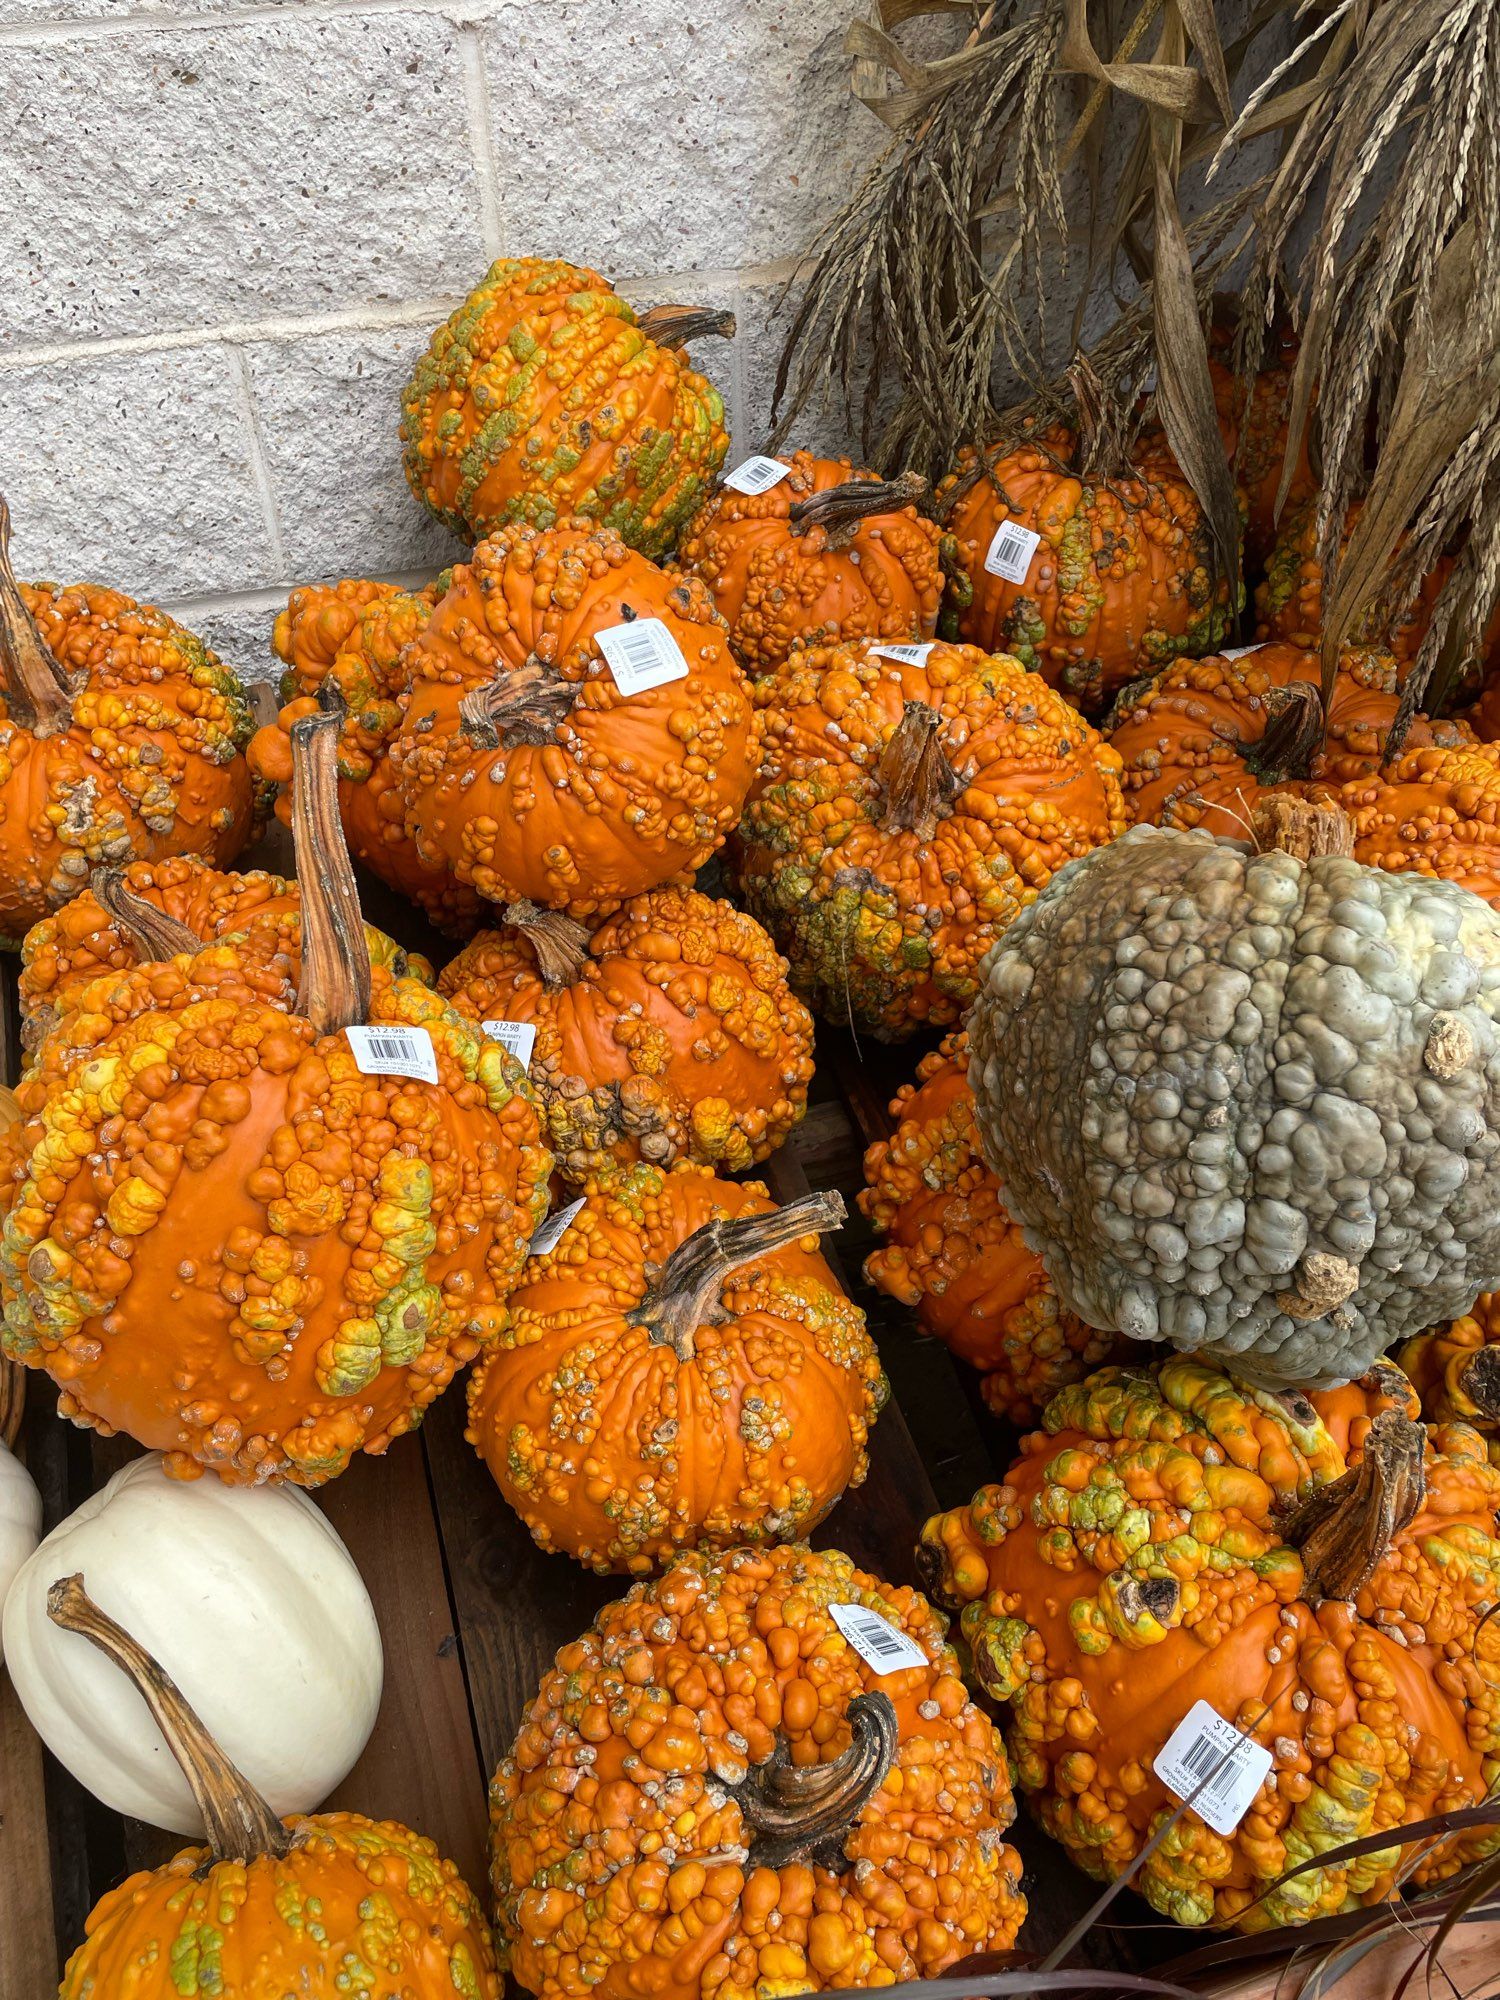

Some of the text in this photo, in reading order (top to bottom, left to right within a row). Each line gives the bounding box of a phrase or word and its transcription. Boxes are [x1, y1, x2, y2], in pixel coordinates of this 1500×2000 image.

[1010, 525, 1030, 539] $12.98
[603, 646, 625, 677] $12.98
[494, 1022, 520, 1033] $12.98
[842, 1627, 871, 1657] $12.98
[1201, 1725, 1230, 1751] PUMPKIN
[1214, 1719, 1253, 1754] $12.98
[1162, 1765, 1223, 1822] GROWN FOR NURSERY
